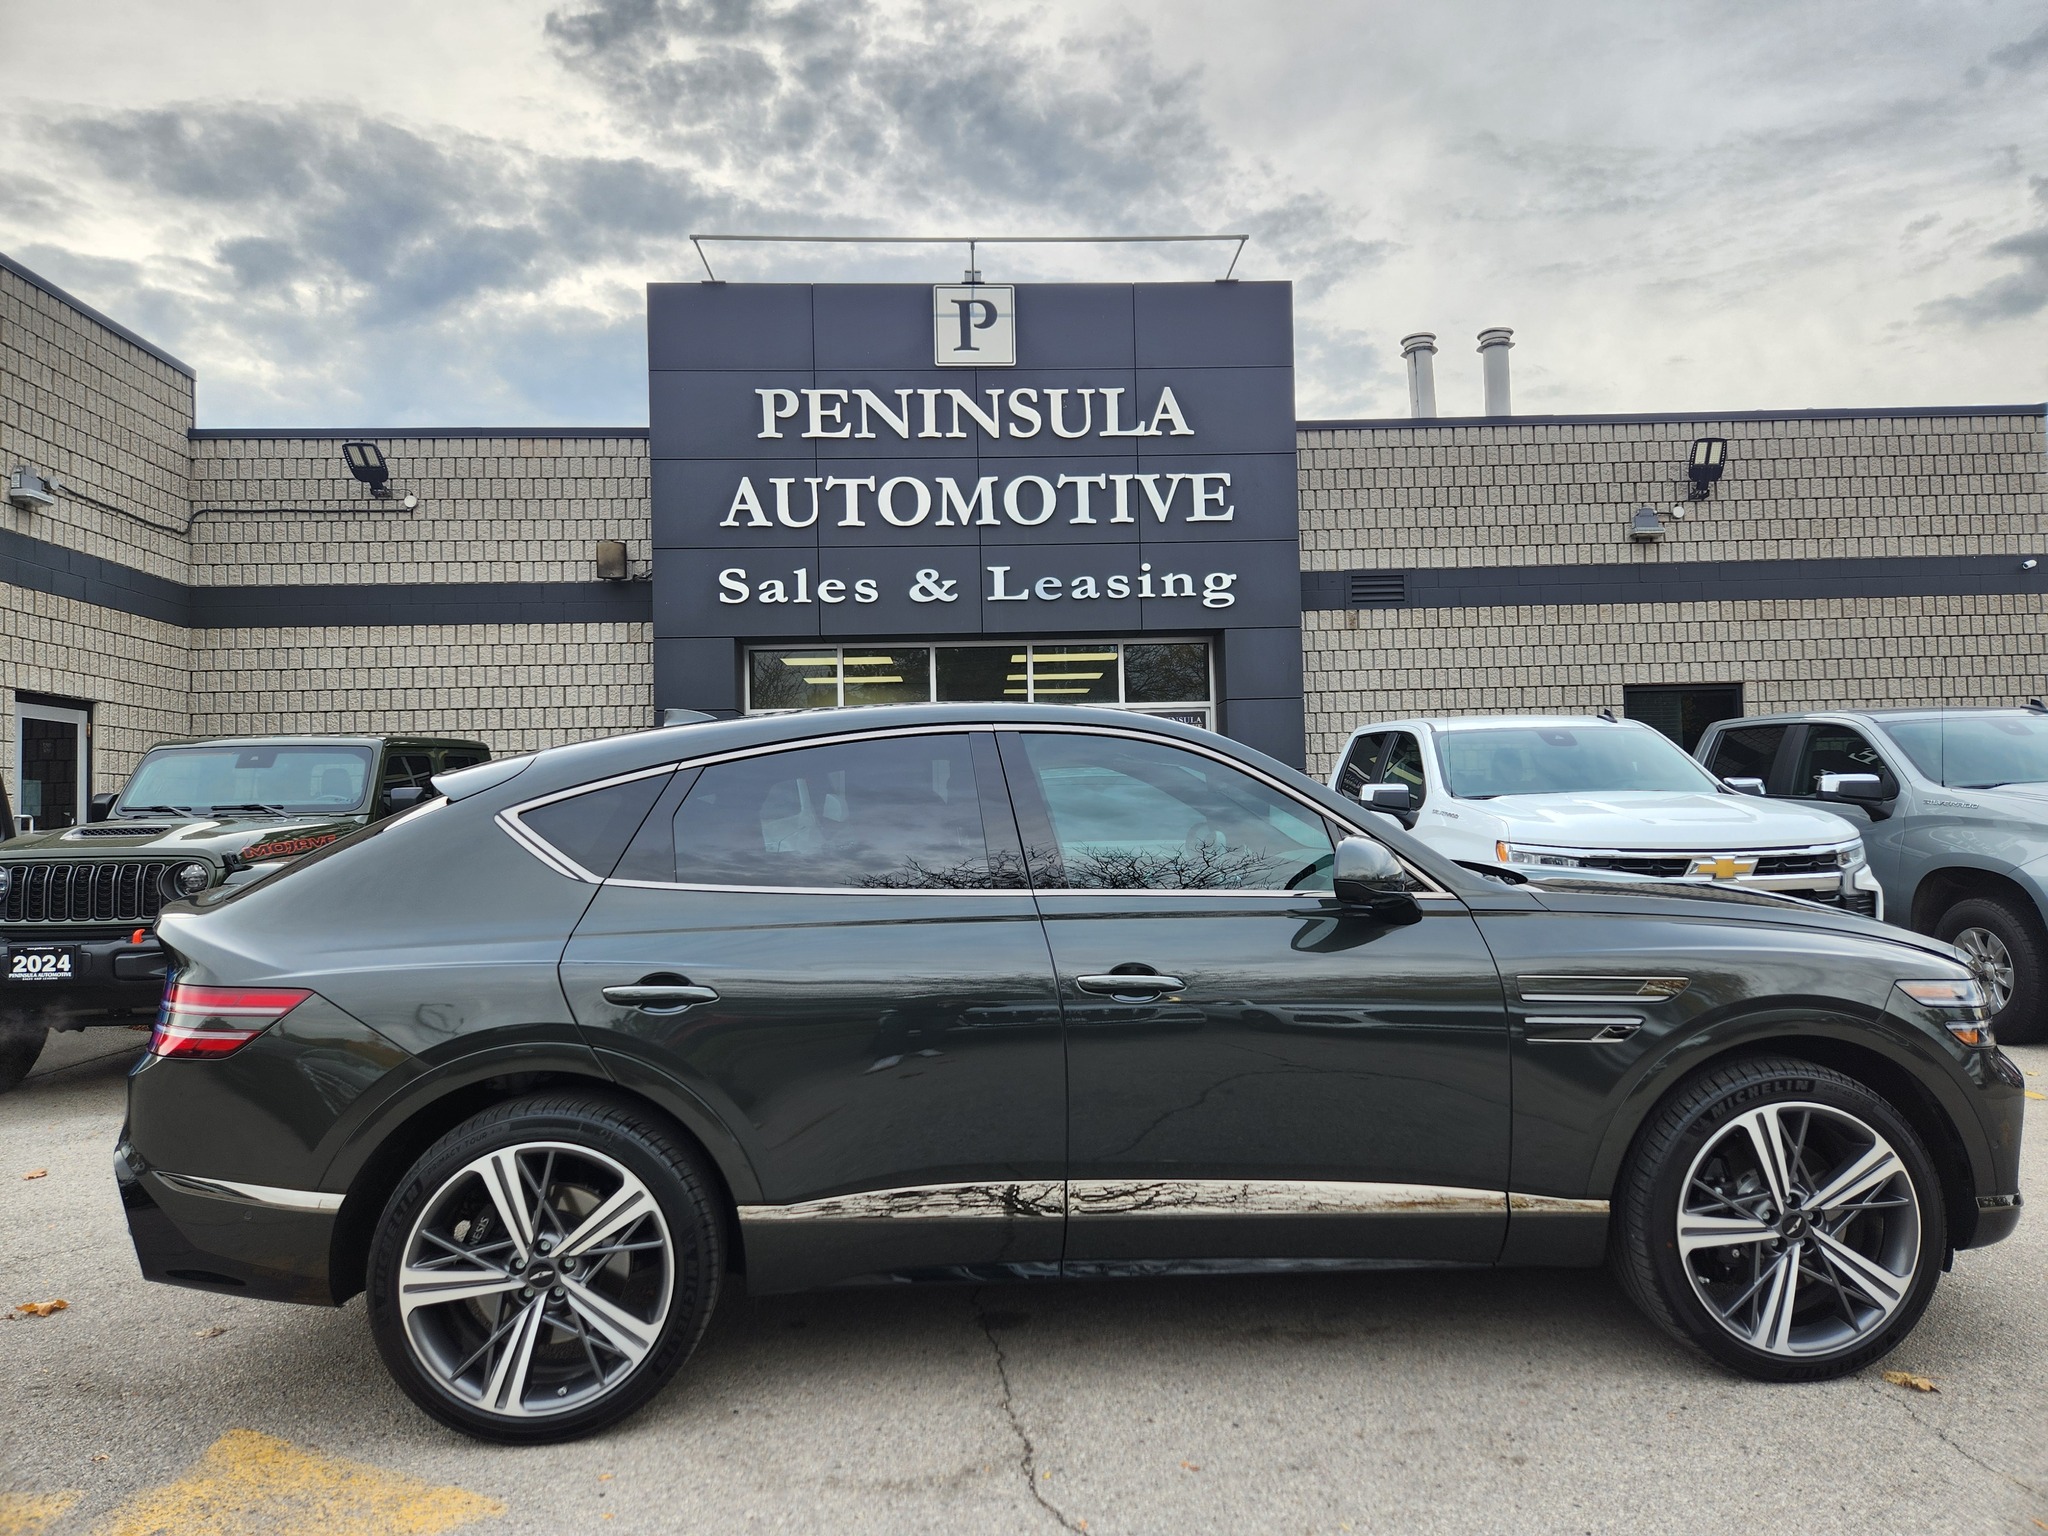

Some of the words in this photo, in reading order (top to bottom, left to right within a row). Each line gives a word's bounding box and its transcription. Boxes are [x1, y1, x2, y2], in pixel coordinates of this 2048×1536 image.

[950, 299, 998, 352] P
[755, 386, 1195, 440] PENINSULA
[719, 472, 1235, 529] AUTOMOTIVE
[718, 568, 879, 605] Sales
[909, 568, 958, 603] &
[987, 563, 1238, 609] Leasing
[239, 834, 336, 858] MOJAVE
[12, 954, 71, 973] 2024
[1711, 1079, 1808, 1120] MICHELIN
